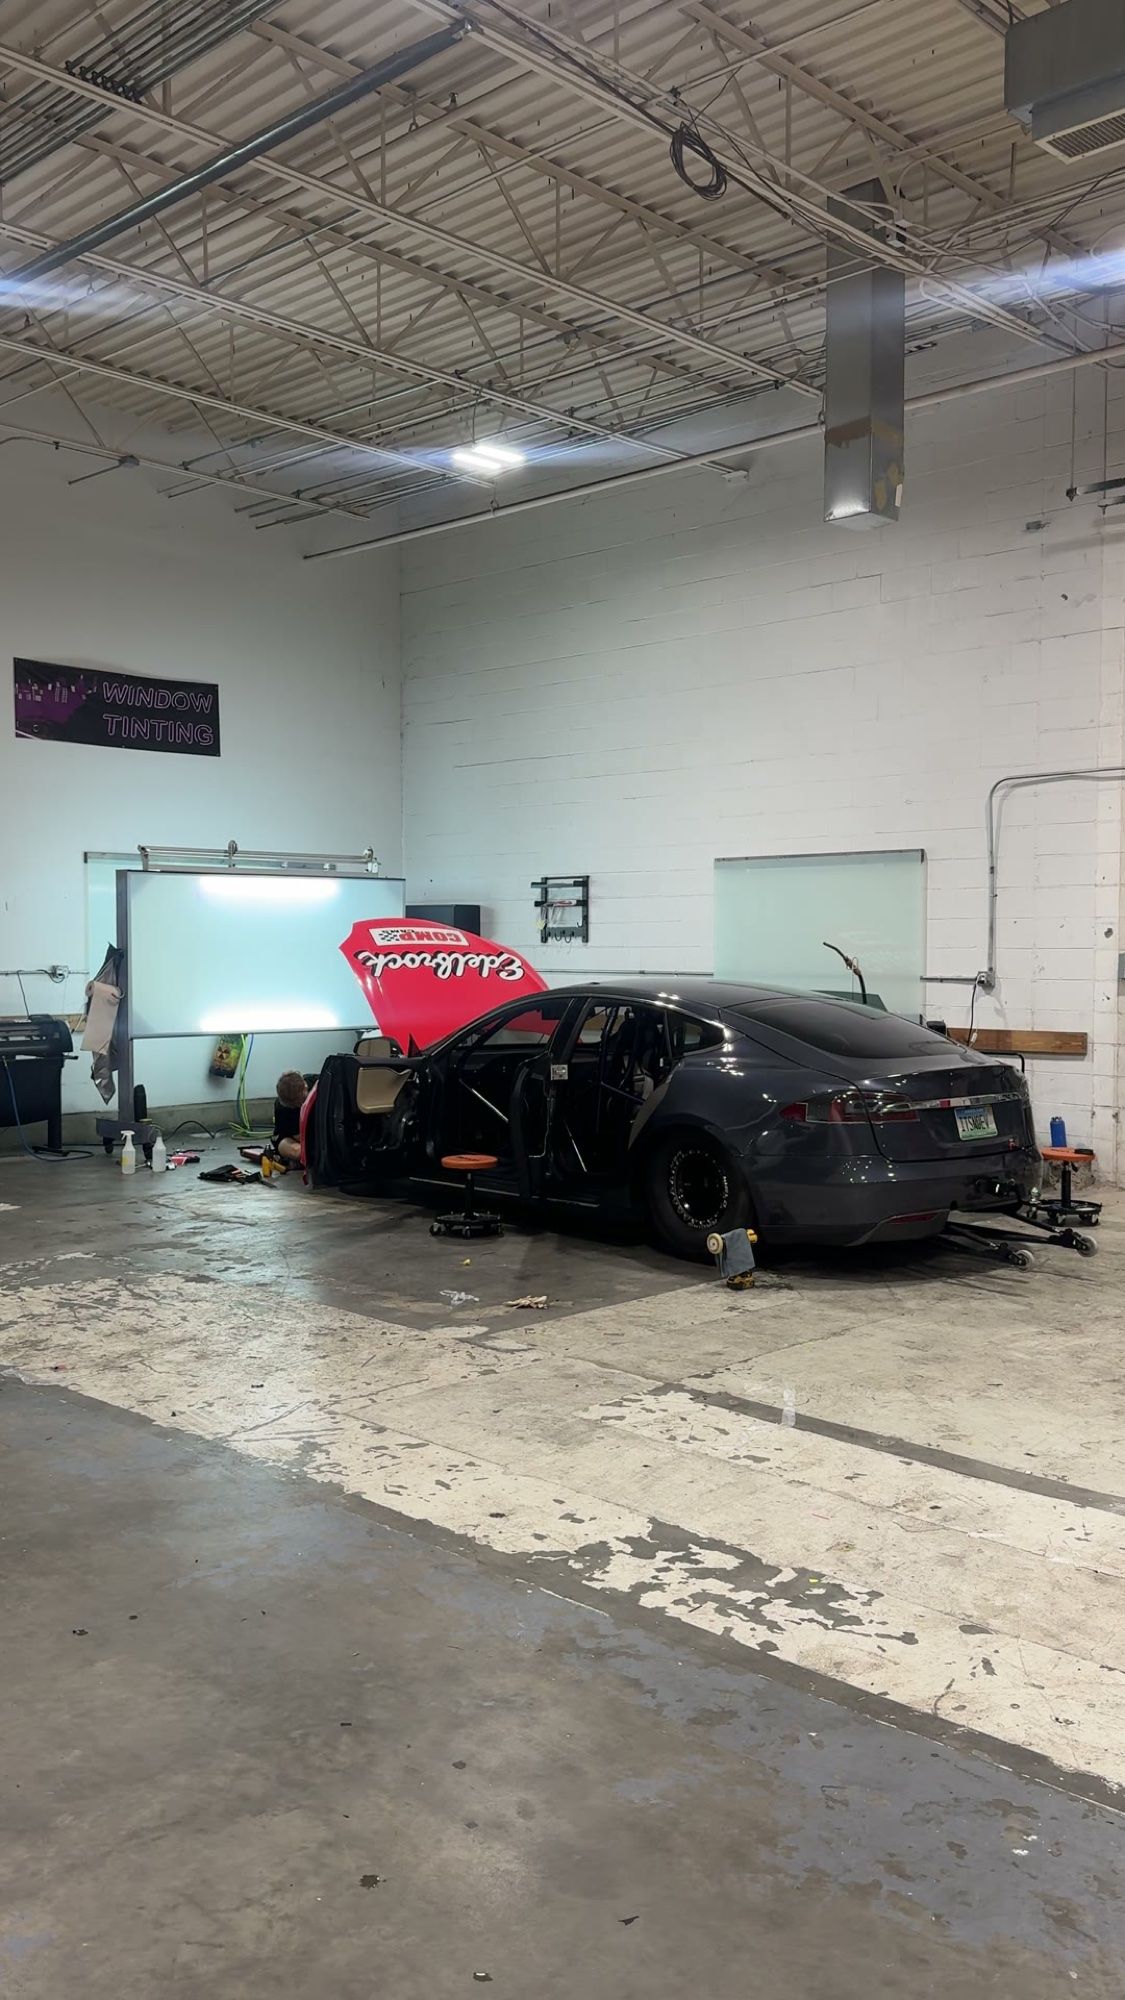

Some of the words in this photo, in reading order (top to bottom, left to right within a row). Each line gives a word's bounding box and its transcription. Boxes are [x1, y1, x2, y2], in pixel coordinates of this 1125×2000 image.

[103, 682, 212, 713] WINDOW
[103, 714, 214, 745] TINTING
[399, 931, 461, 941] COMP
[354, 950, 525, 981] Edelbrock
